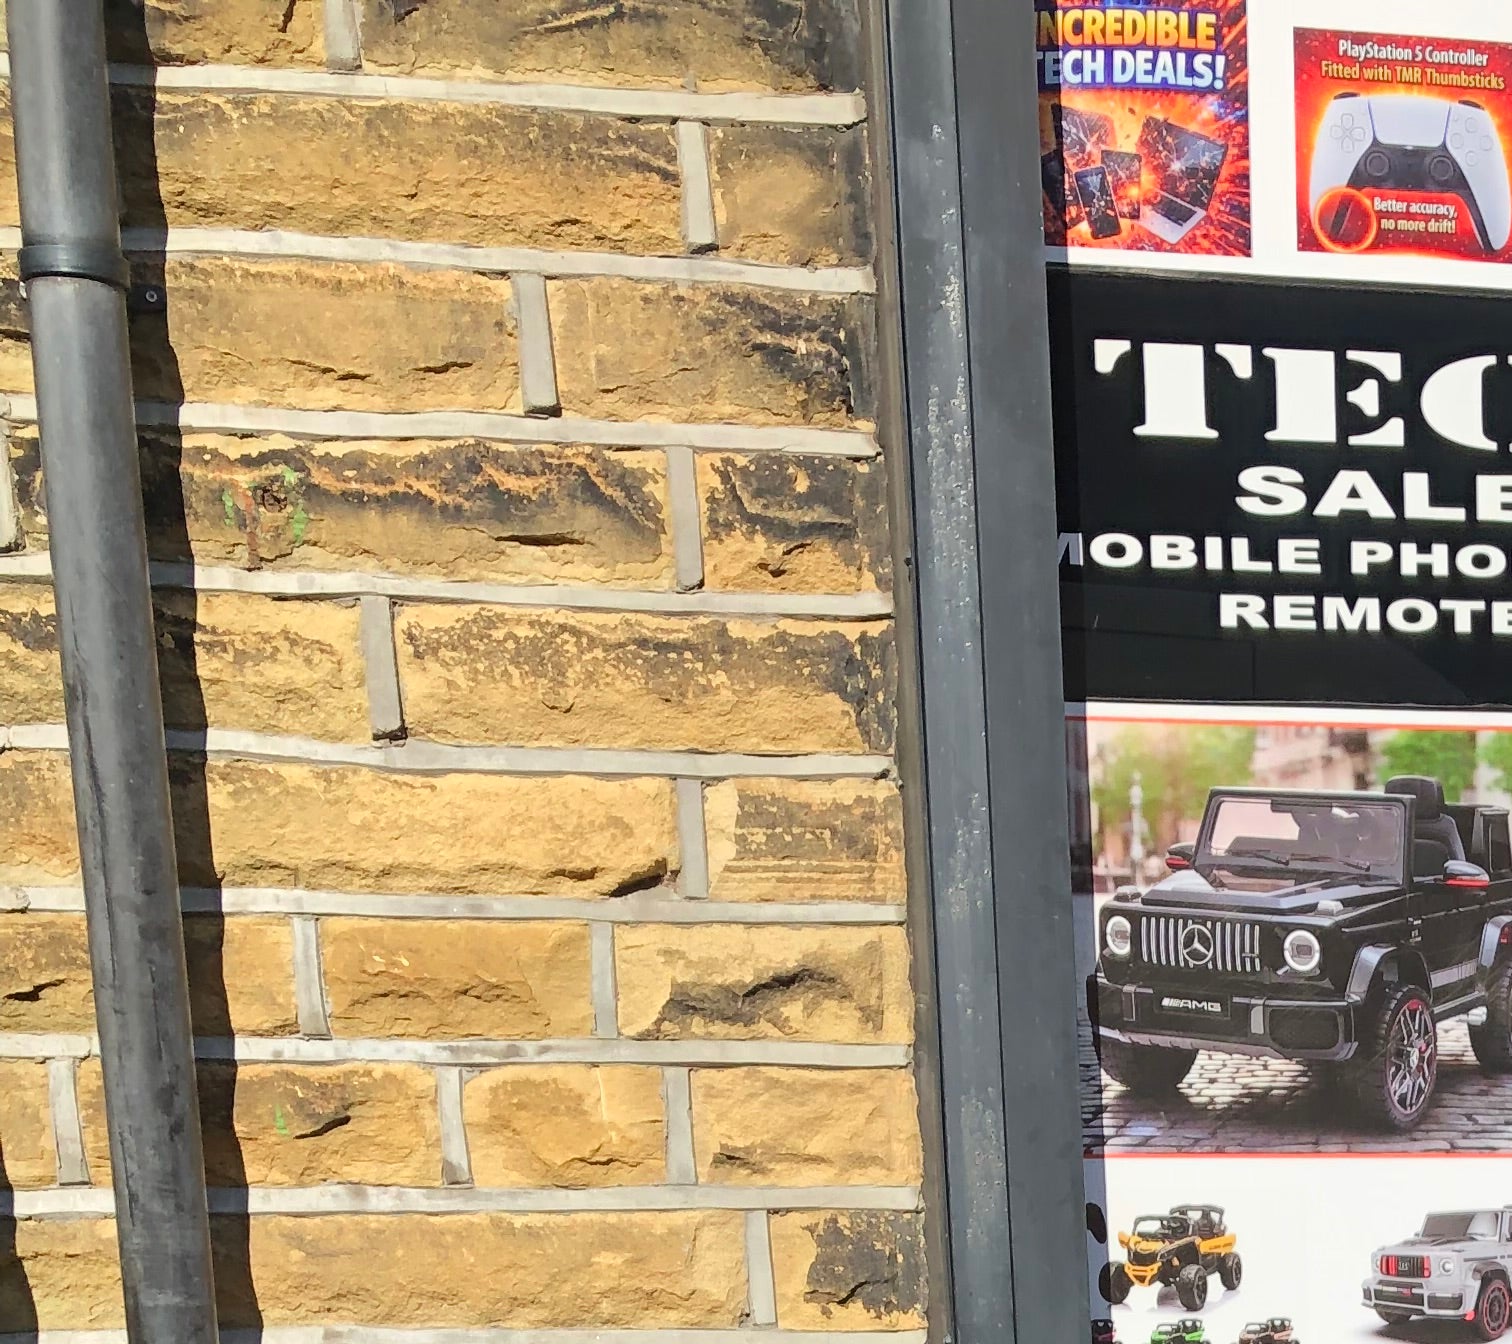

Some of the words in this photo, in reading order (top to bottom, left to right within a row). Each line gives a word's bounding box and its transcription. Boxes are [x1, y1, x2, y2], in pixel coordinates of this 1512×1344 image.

[1338, 39, 1412, 61] PlayStation
[1415, 45, 1422, 62] 5
[1425, 46, 1489, 66] Controller
[1112, 50, 1227, 90] DEALS!
[1321, 60, 1360, 79] Fitted
[1363, 64, 1392, 81] with
[1395, 66, 1422, 83] TMR
[1425, 67, 1505, 89] Thumbsticks
[1374, 196, 1408, 212] Better
[1409, 202, 1459, 219] accuracy,
[1380, 218, 1395, 230] no
[1397, 219, 1426, 232] more
[1427, 218, 1457, 234] drift!
